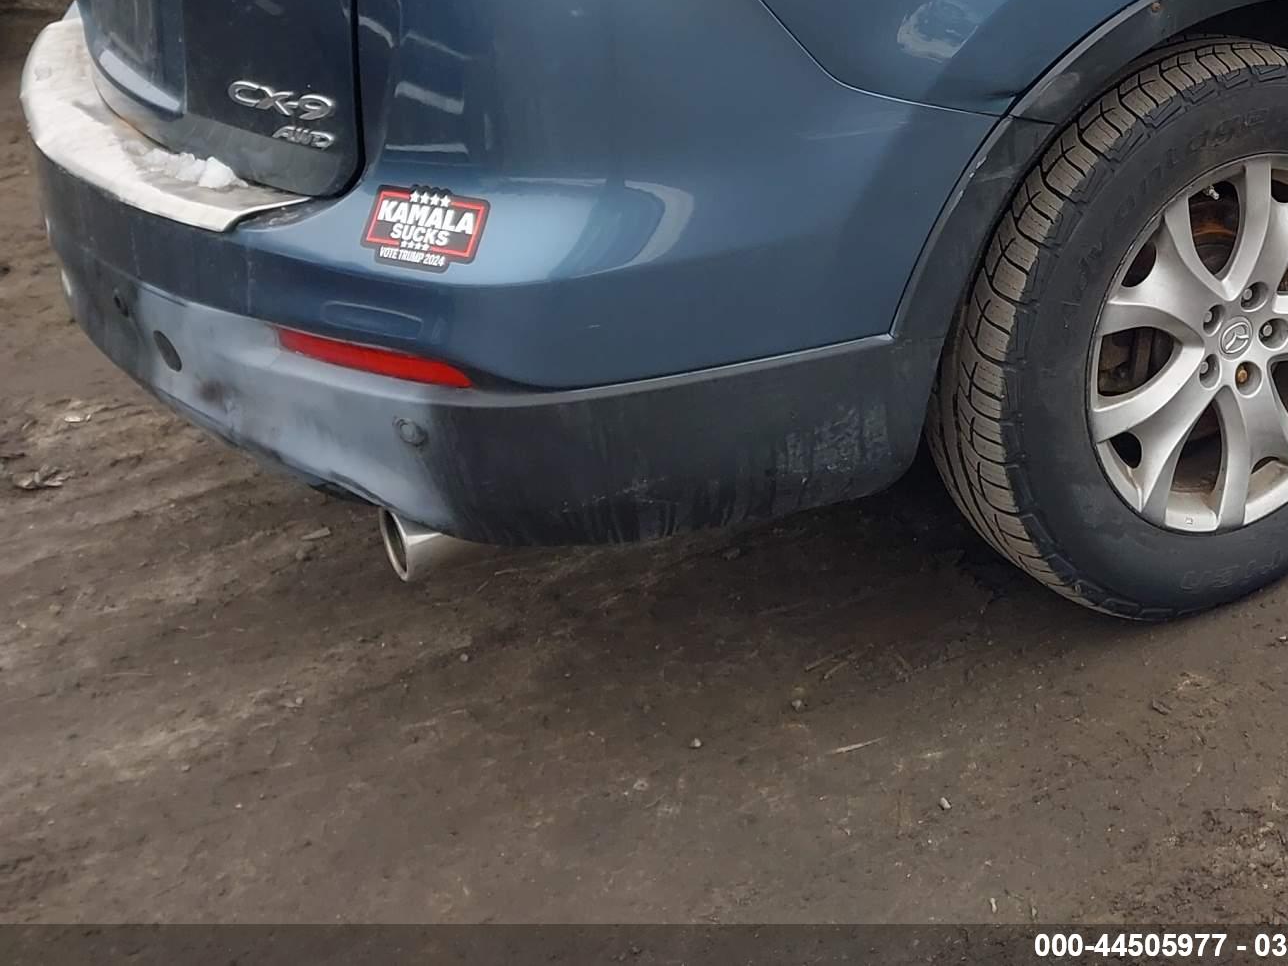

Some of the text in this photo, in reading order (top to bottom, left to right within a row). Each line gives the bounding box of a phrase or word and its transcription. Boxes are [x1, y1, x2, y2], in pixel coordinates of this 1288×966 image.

[228, 81, 335, 120] CX-9
[272, 125, 334, 150] AWD
[377, 199, 474, 235] KAMALA
[390, 222, 451, 246] SUCKS
[379, 245, 447, 267] VOTE TRUMP 2024
